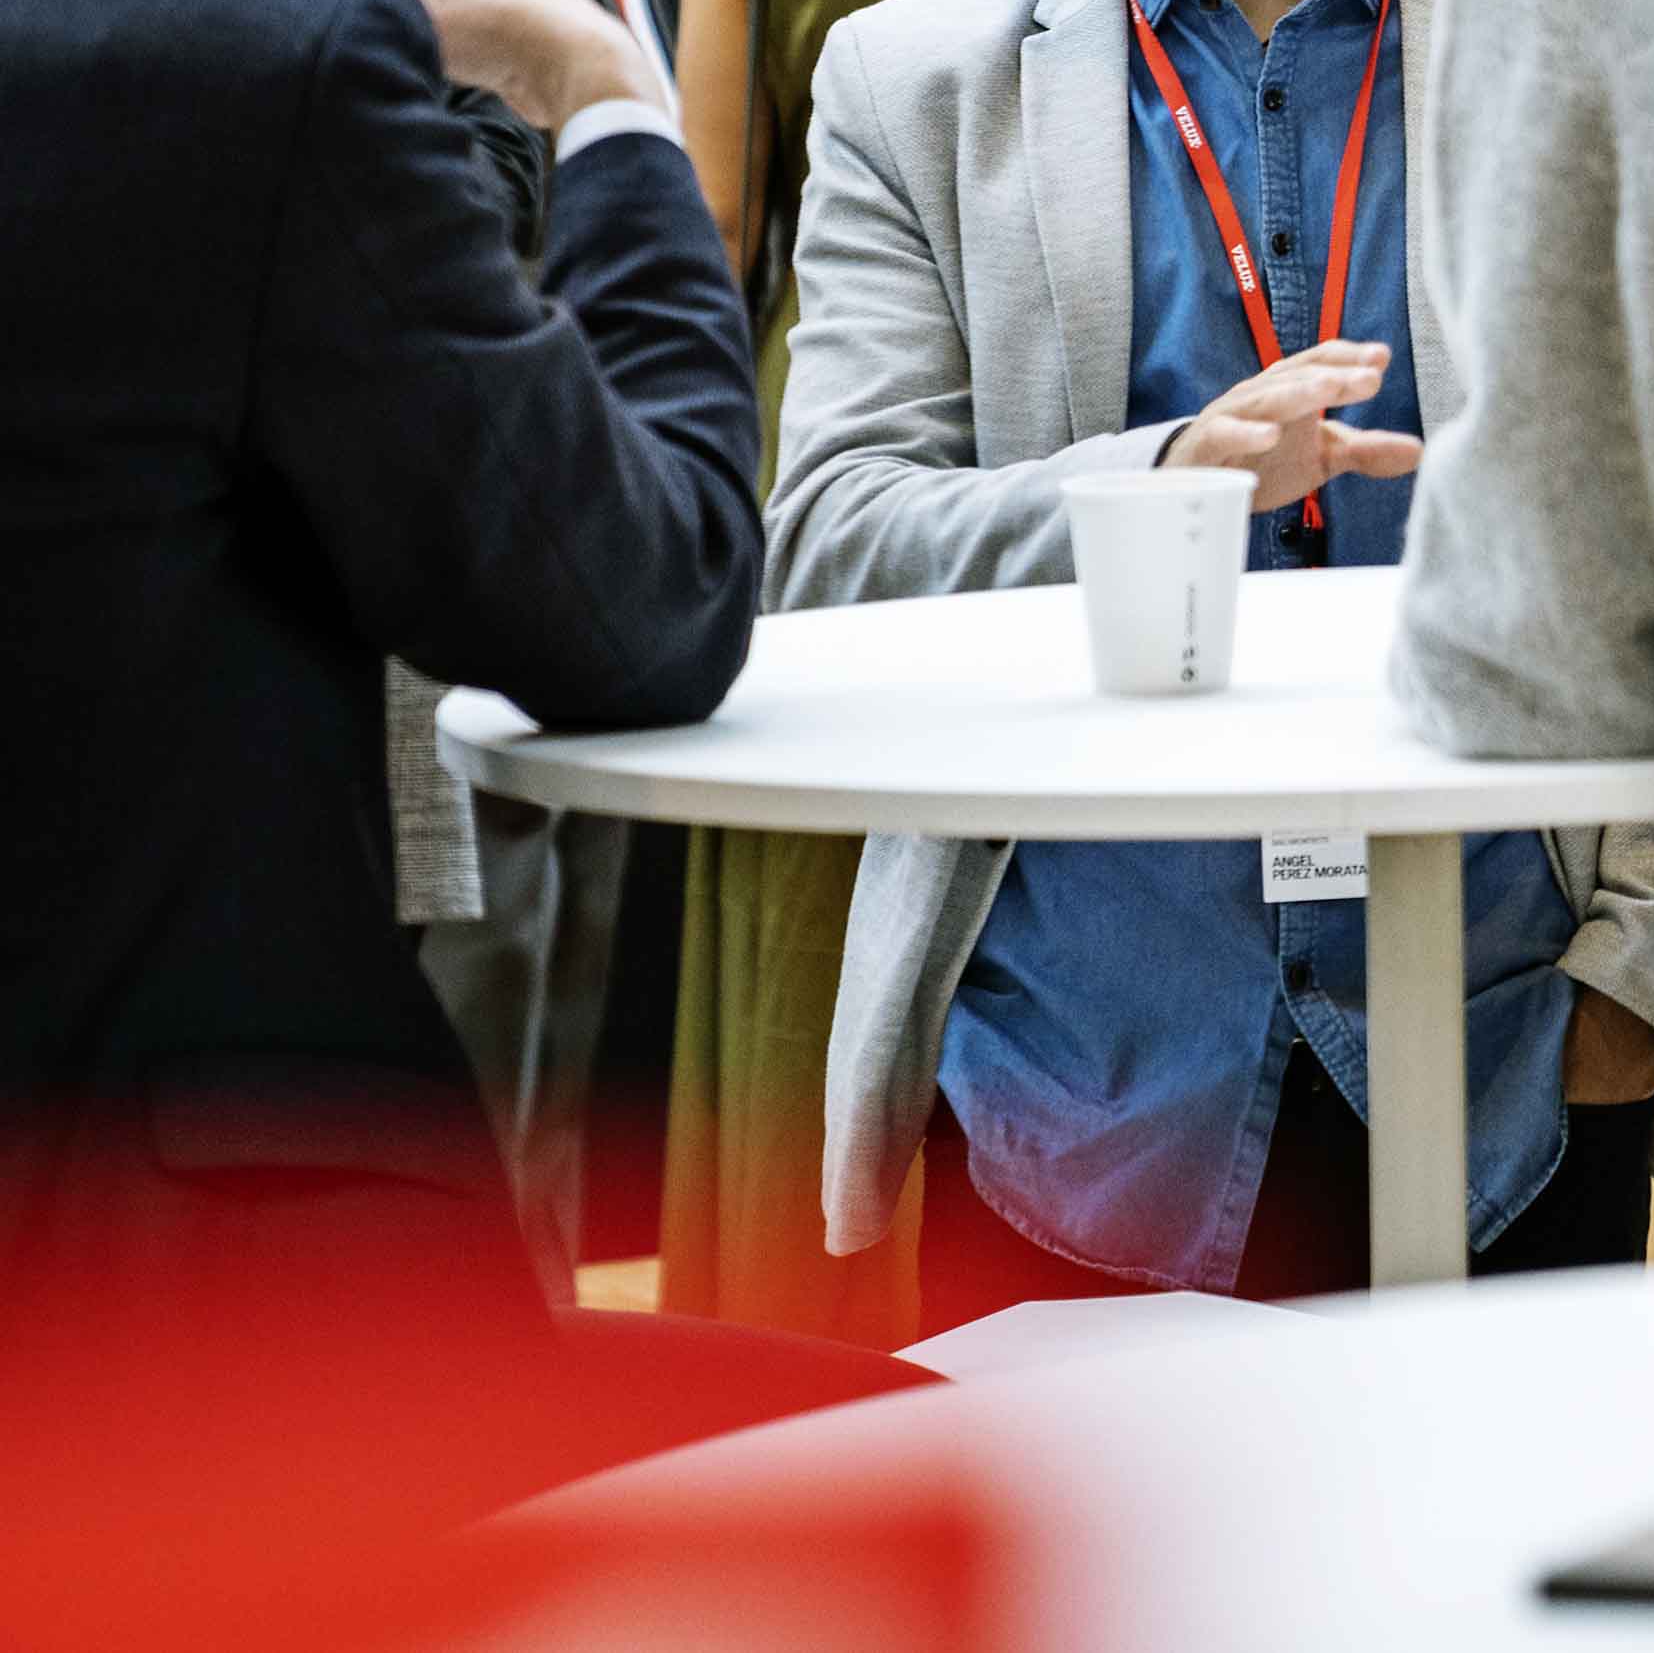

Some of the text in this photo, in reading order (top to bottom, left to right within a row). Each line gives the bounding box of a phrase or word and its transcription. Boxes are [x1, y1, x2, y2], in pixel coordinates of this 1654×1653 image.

[1176, 106, 1203, 149] VELUX
[1231, 243, 1256, 292] VELUX
[1273, 854, 1314, 867] ANGEL
[1273, 867, 1312, 881] PEREZ
